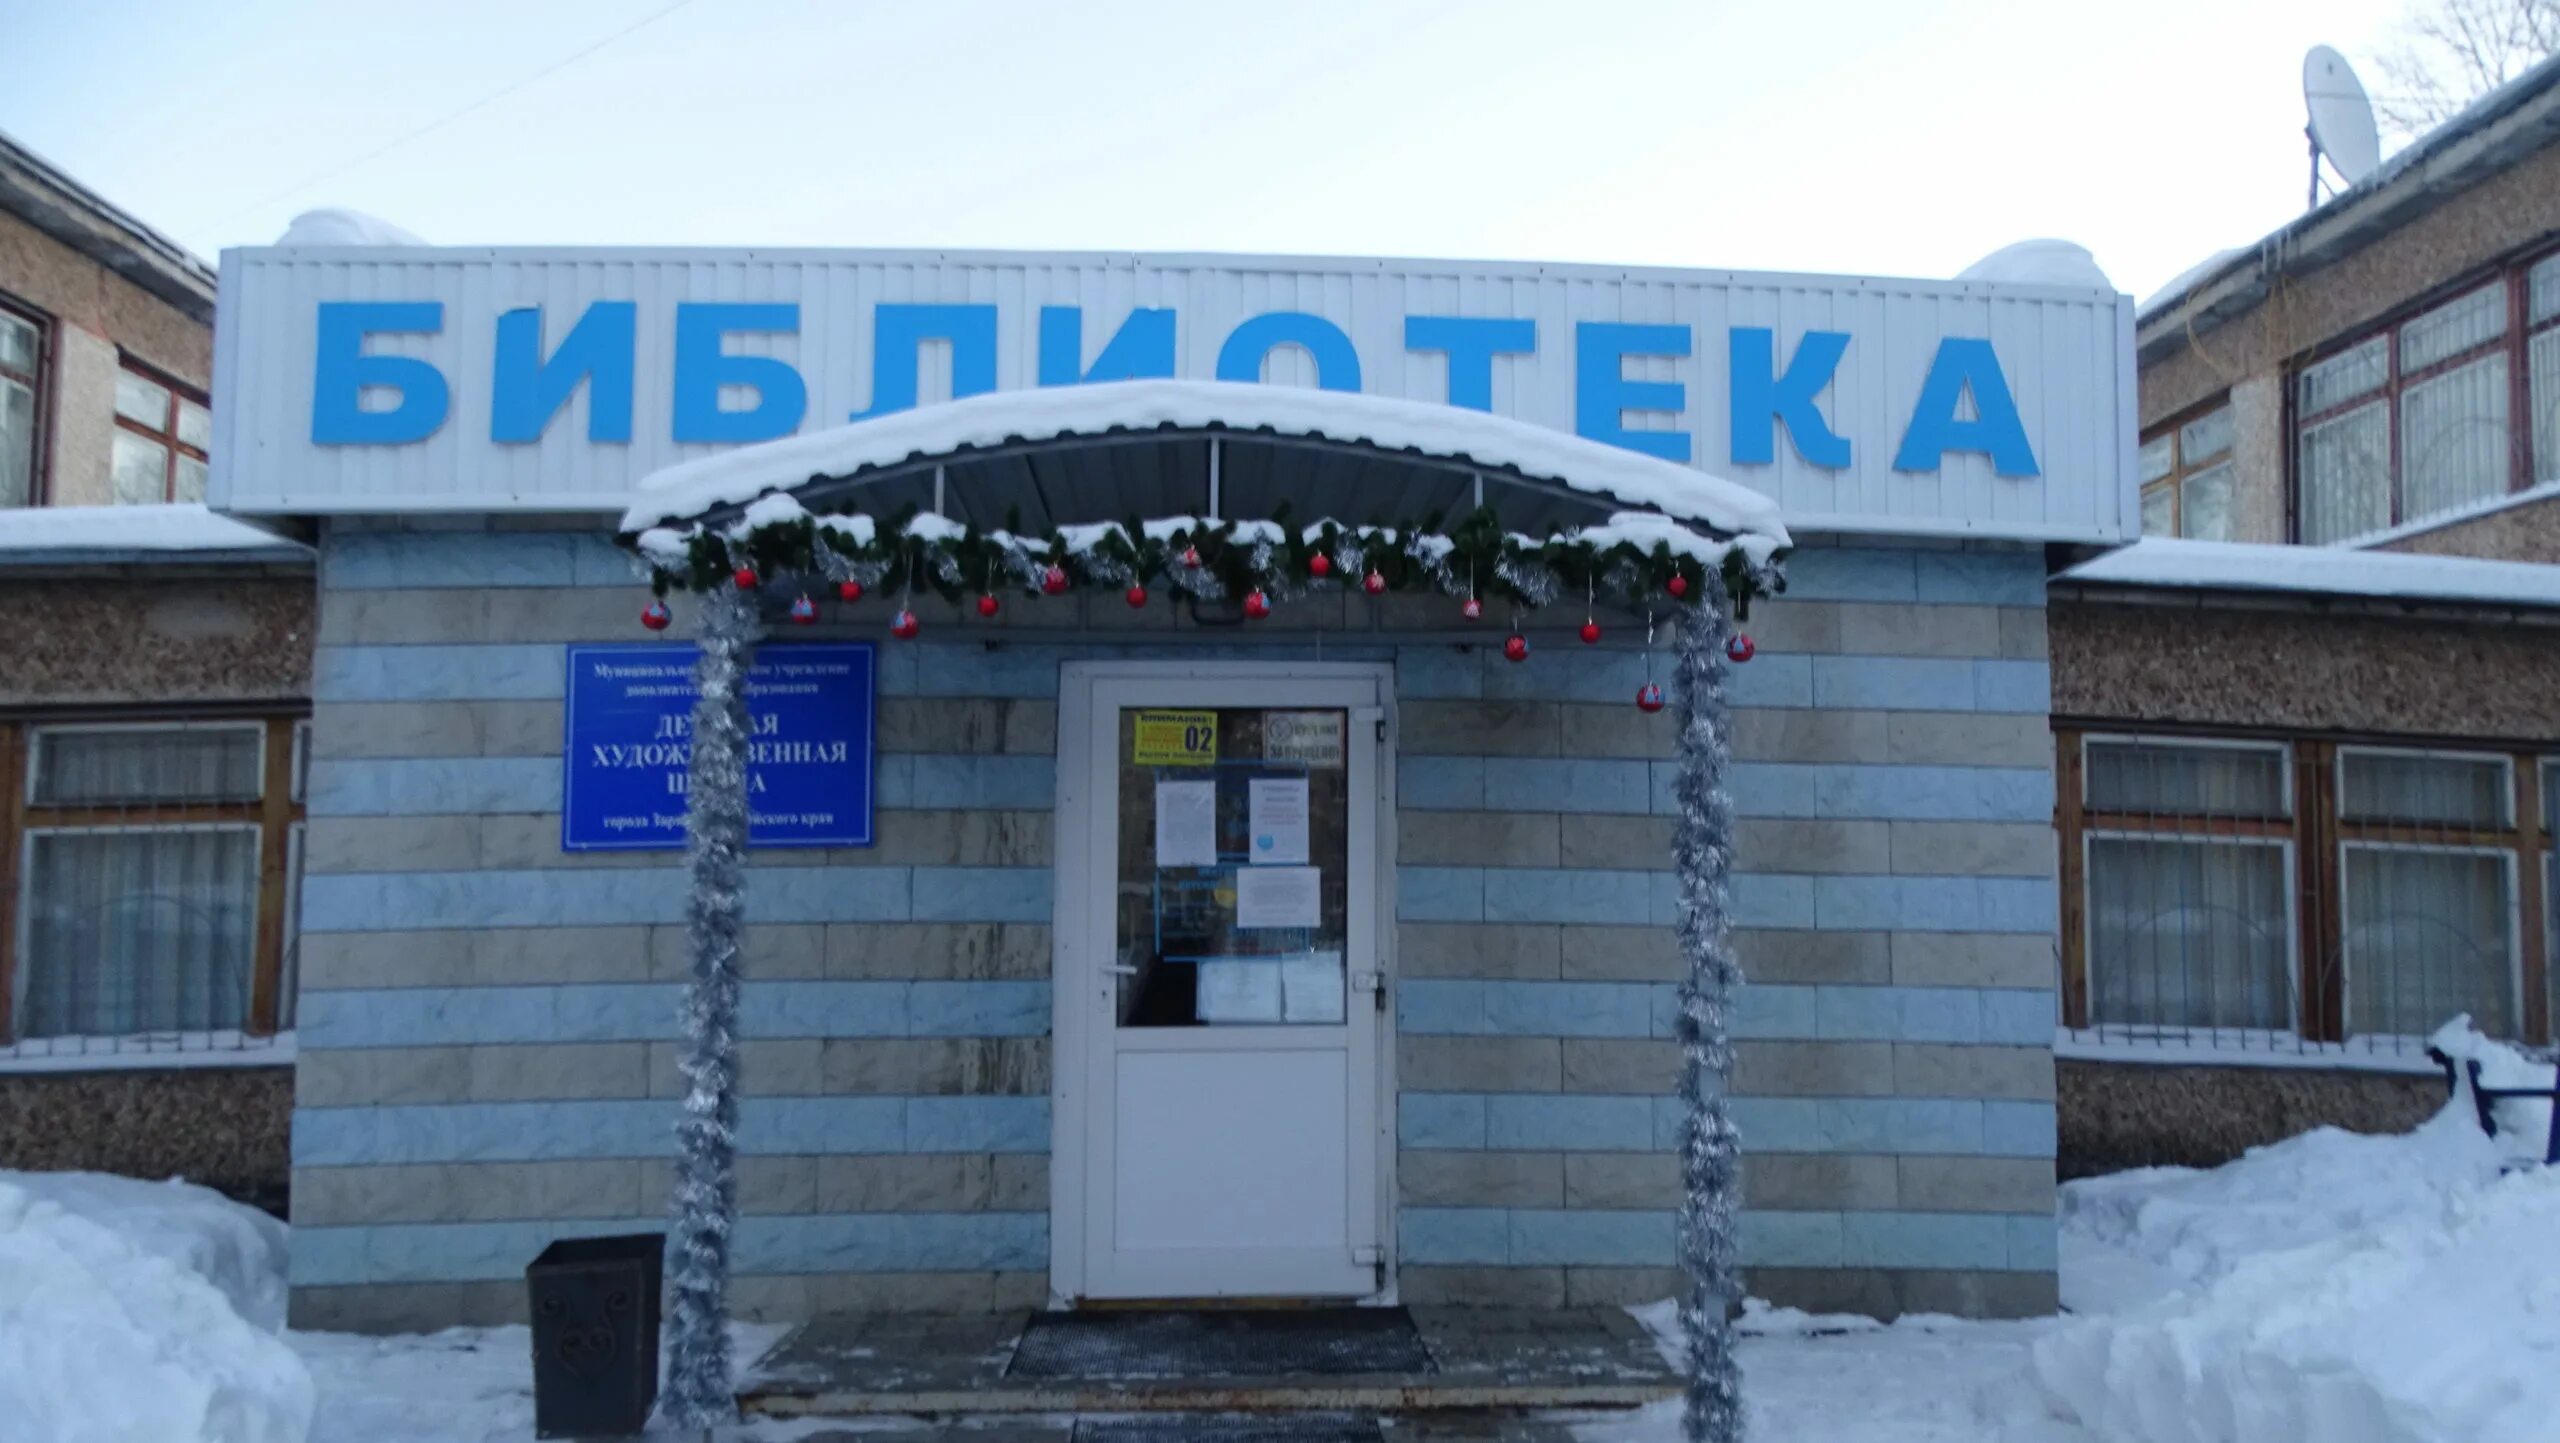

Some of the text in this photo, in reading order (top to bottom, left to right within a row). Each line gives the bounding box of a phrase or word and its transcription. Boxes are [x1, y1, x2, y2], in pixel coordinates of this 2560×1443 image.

[312, 301, 2041, 478] БИБЛИОТЕКА
[655, 712, 779, 740] ДЕАЯ
[1184, 726, 1213, 753] 02
[592, 741, 847, 769] ХУДОЖВЕННАЯ
[801, 812, 834, 830] края
